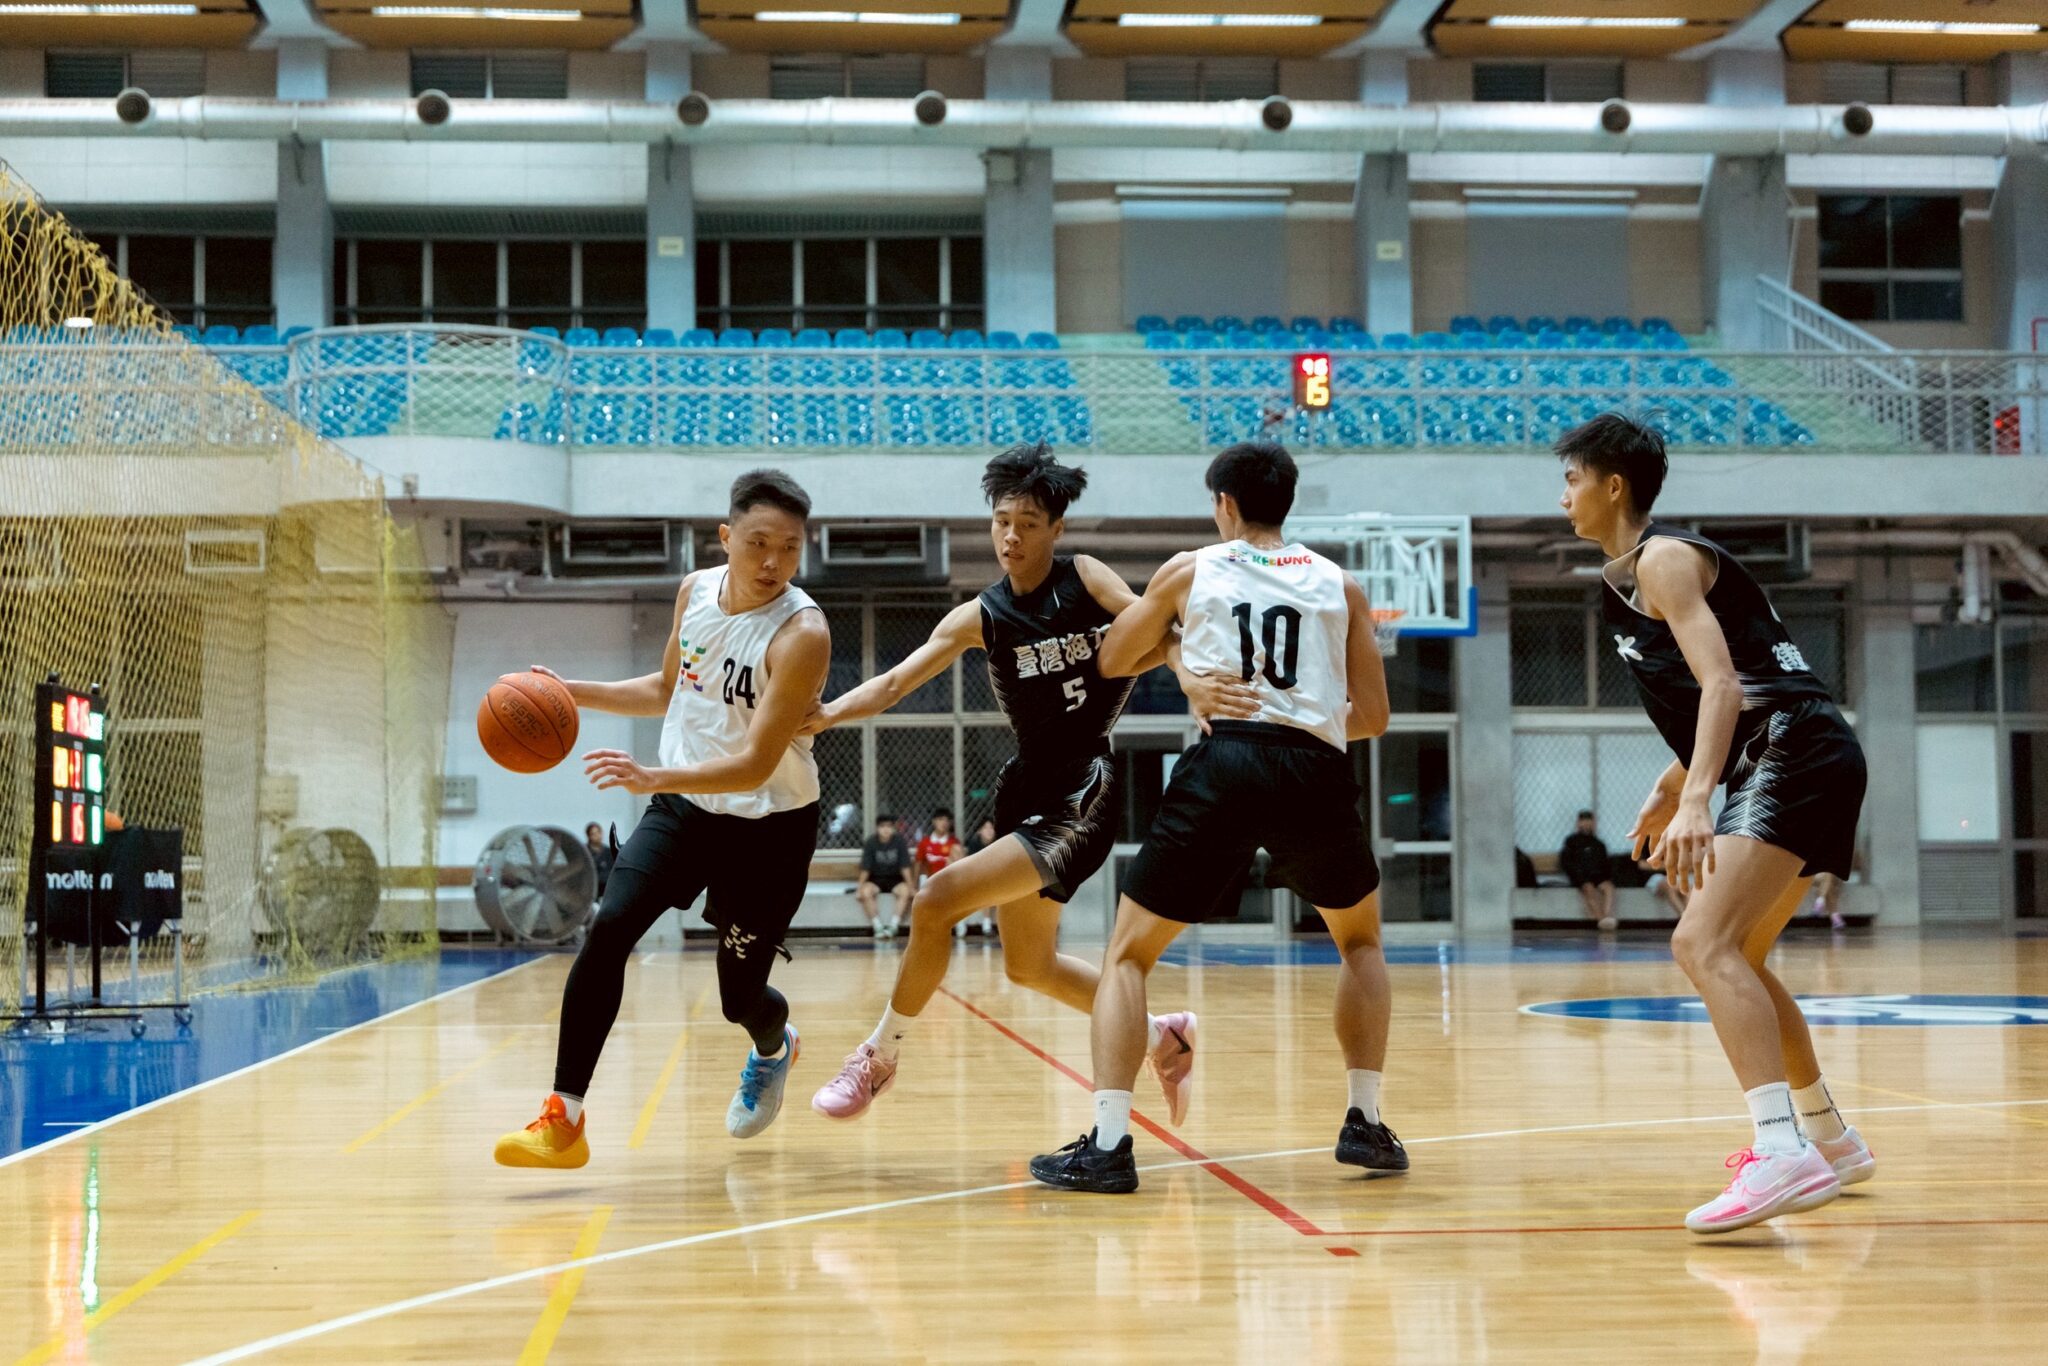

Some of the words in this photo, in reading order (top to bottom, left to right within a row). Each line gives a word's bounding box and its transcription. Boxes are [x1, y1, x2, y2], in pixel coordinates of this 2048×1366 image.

[1232, 602, 1302, 690] 10
[723, 657, 756, 709] 24
[1062, 676, 1087, 712] 5
[46, 869, 112, 890] moltn
